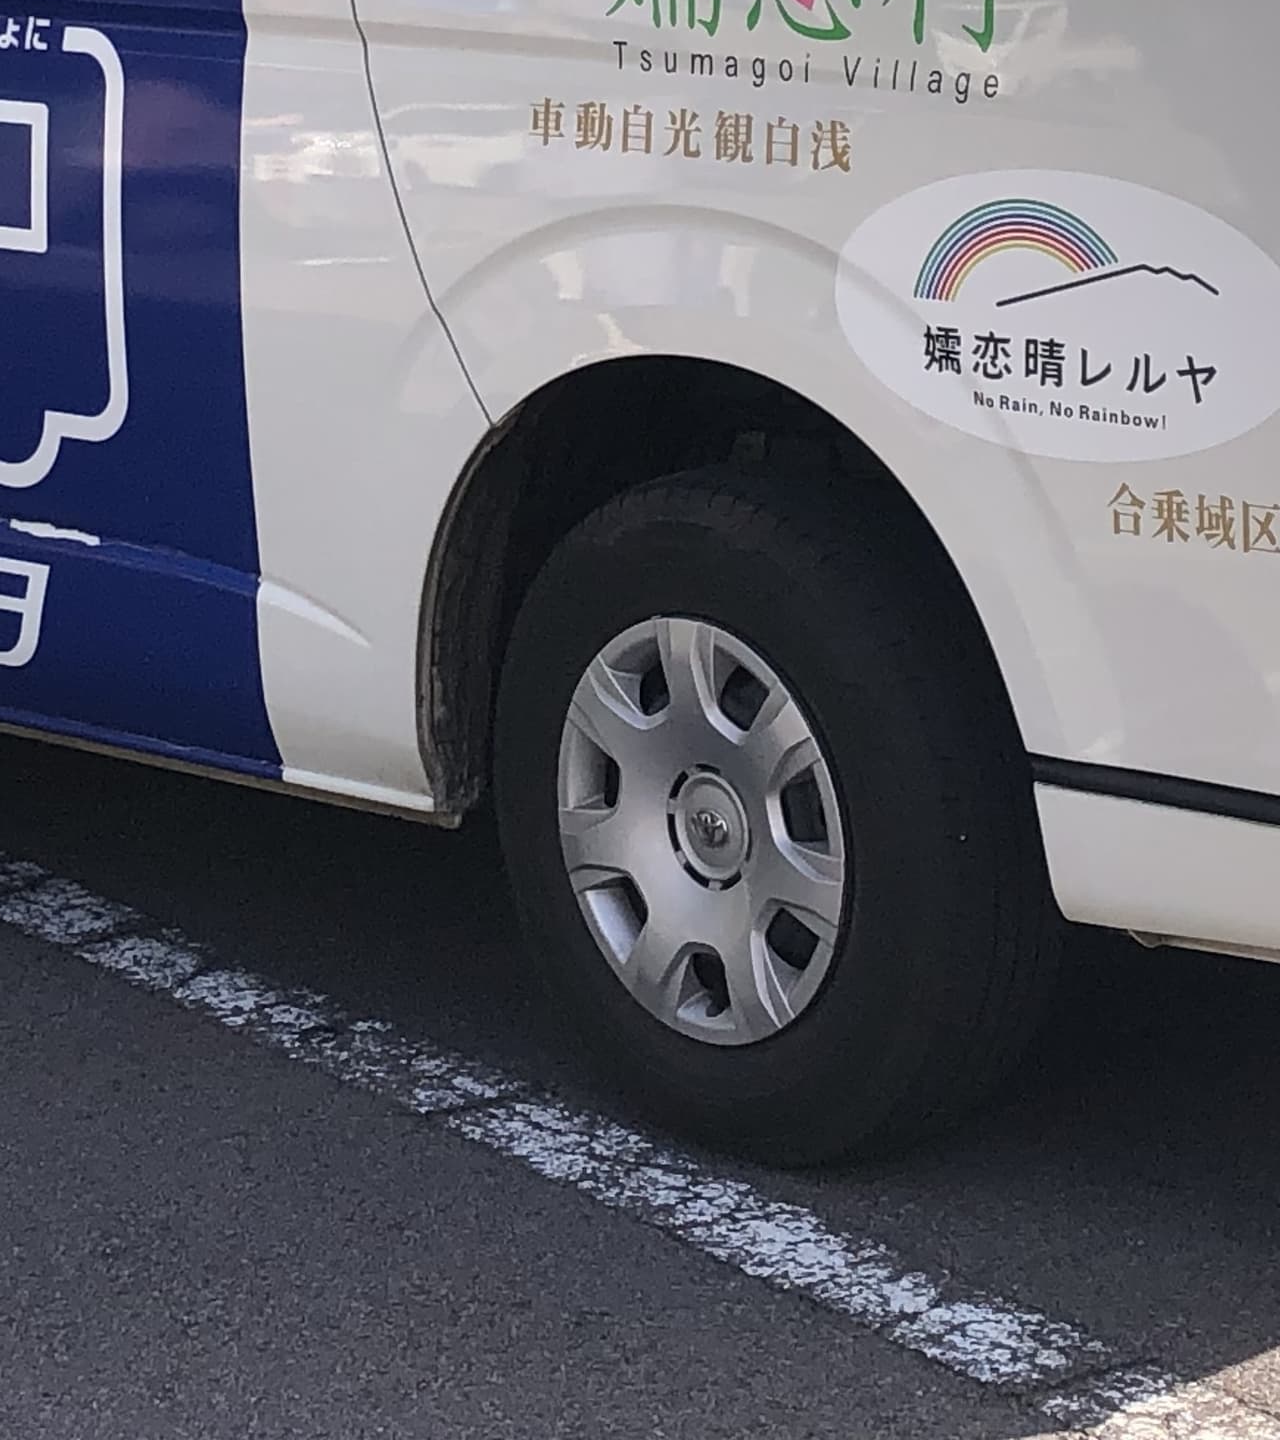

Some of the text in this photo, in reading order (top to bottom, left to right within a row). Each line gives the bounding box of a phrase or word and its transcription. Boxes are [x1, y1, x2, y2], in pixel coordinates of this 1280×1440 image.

[612, 38, 1000, 104] Tsumagoi Village
[923, 325, 1218, 405] 嬬恋晴レルヤ
[973, 390, 995, 409] No
[999, 395, 1045, 417] Rain,
[1049, 400, 1074, 419] No
